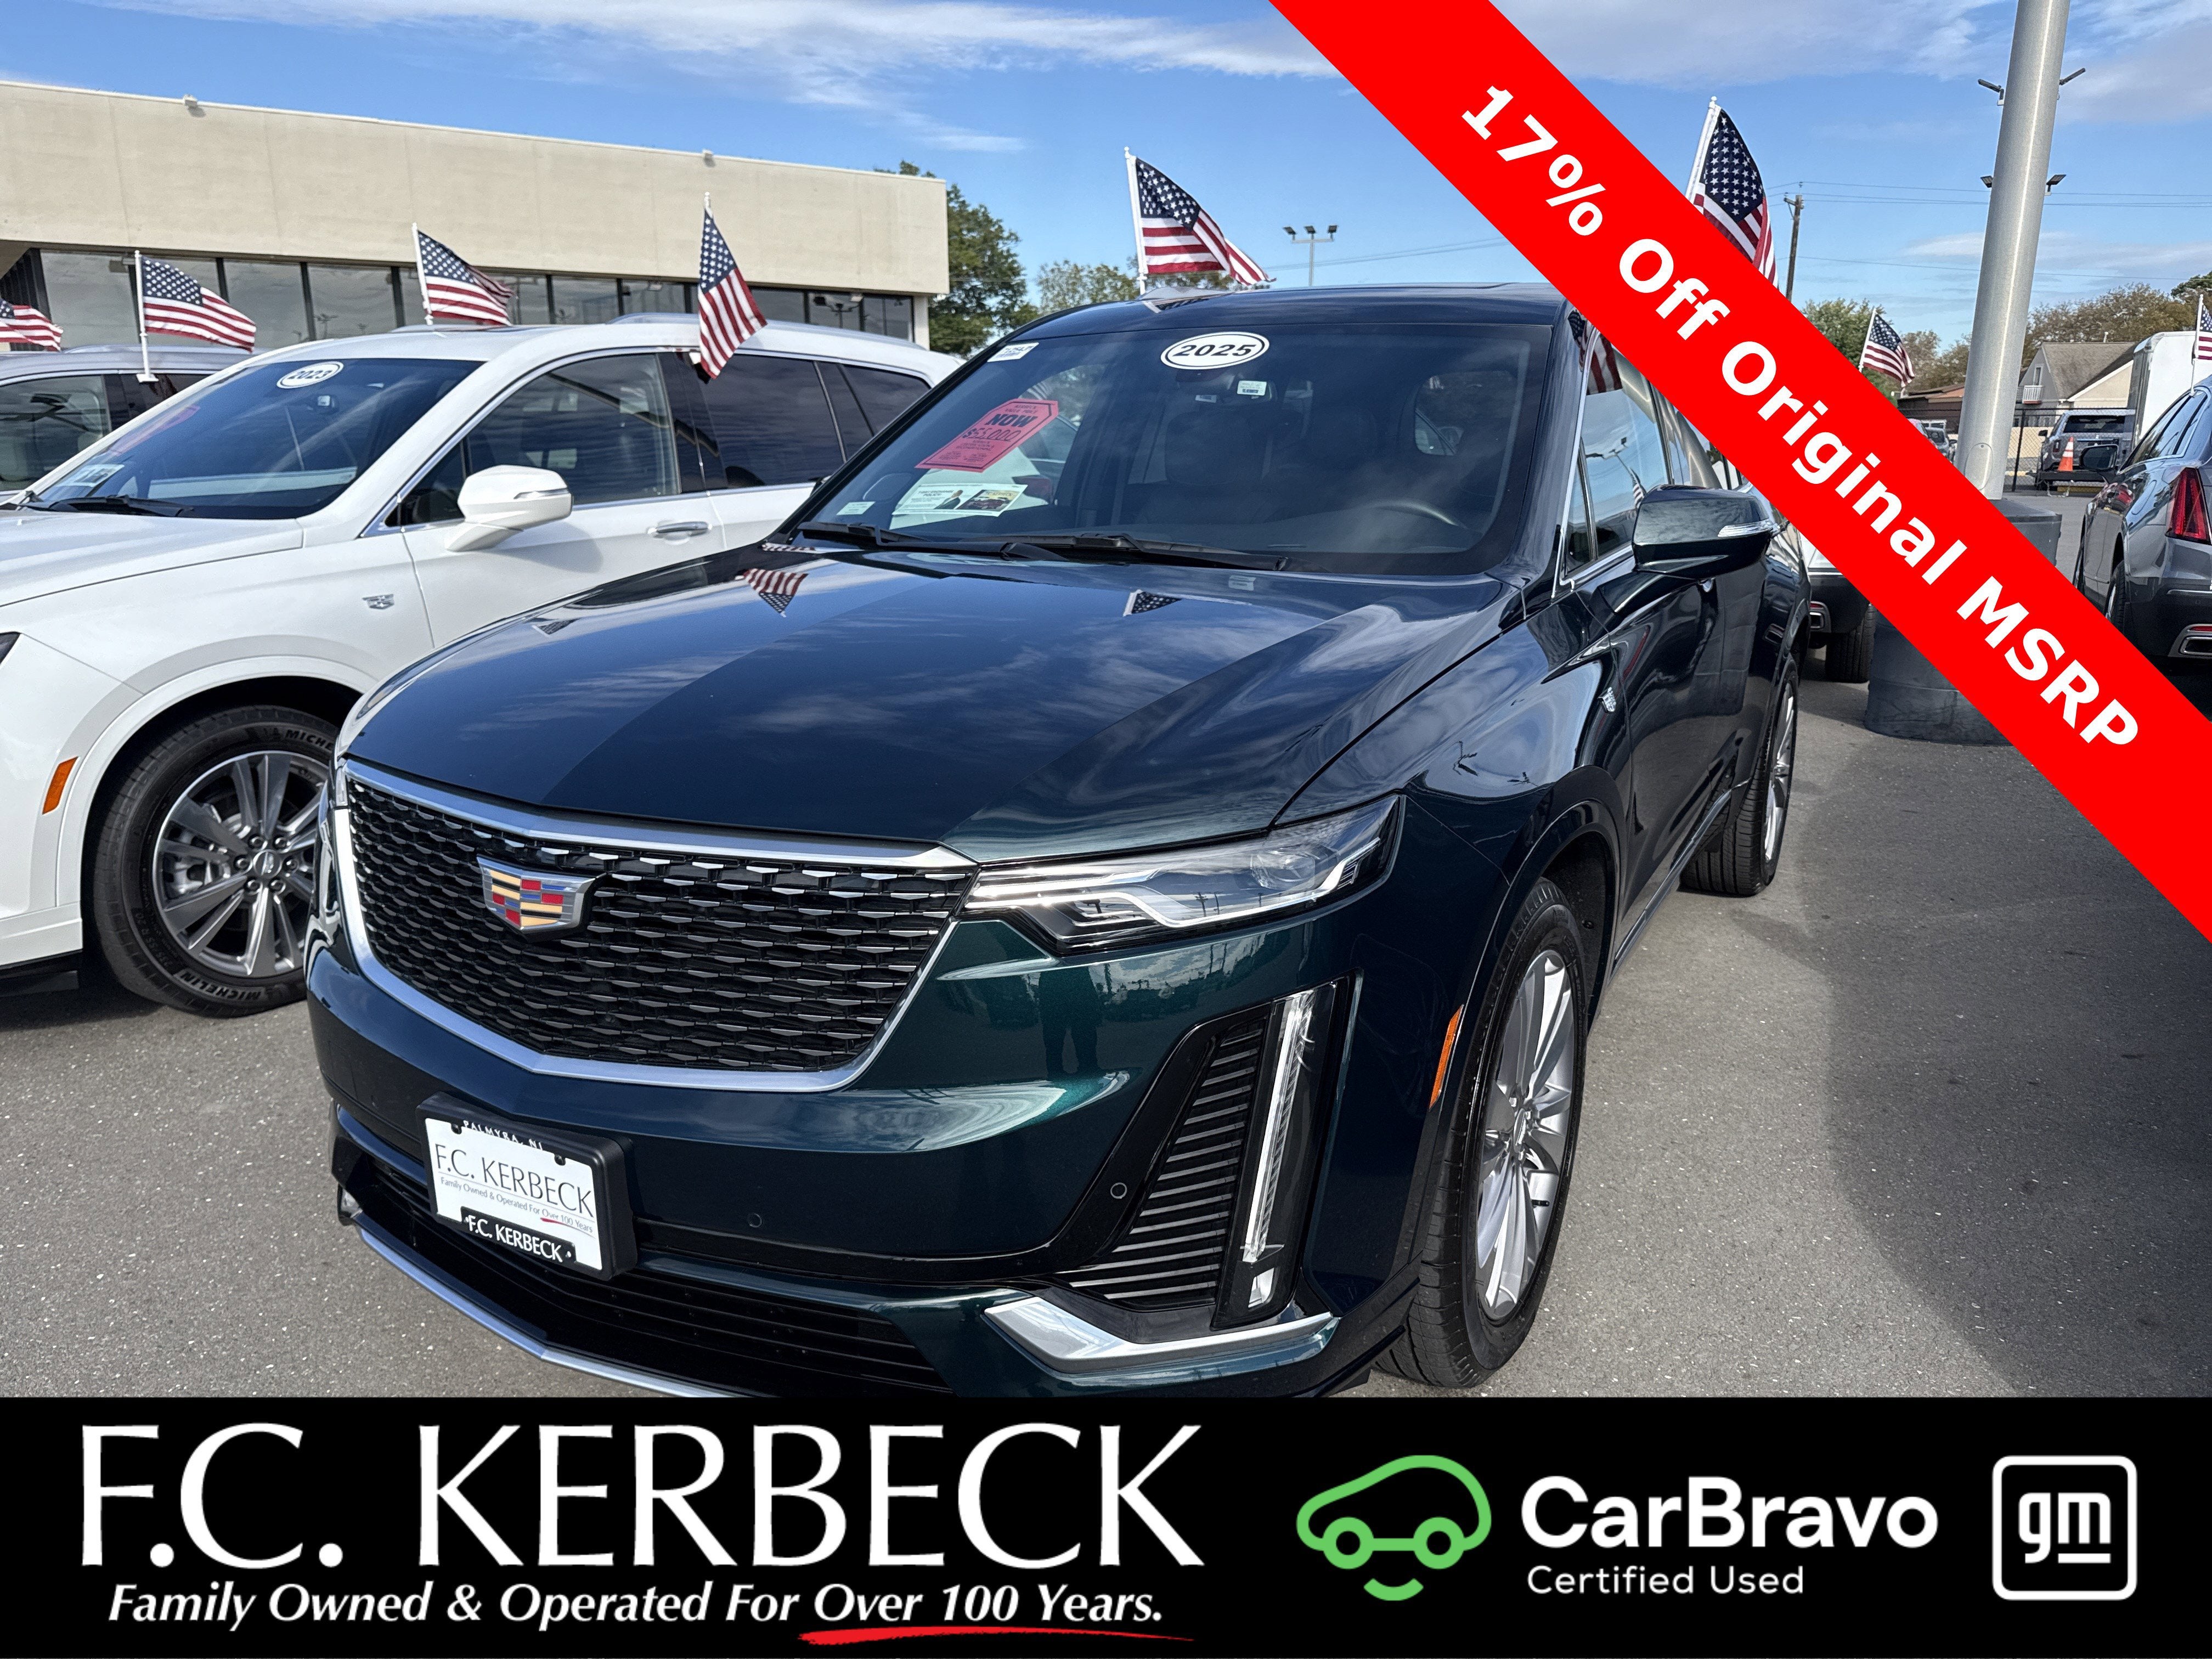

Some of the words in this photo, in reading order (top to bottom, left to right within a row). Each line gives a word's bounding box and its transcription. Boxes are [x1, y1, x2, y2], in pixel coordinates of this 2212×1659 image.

[1172, 344, 1257, 357] 2025
[287, 370, 332, 380] 2023
[985, 413, 1039, 428] NOW
[180, 972, 261, 1001] MICHELIN
[435, 1144, 475, 1179] F.C.
[482, 1157, 594, 1218] KERBECK
[441, 1177, 462, 1190] Family
[463, 1183, 488, 1198] Owned
[489, 1192, 495, 1200] &
[496, 1194, 528, 1210] Operated
[529, 1204, 540, 1215] For
[541, 1209, 559, 1220] Over
[560, 1215, 573, 1226] 100
[575, 1220, 593, 1233] Years
[468, 1215, 493, 1238] F.C.
[495, 1224, 563, 1262] KERBECK
